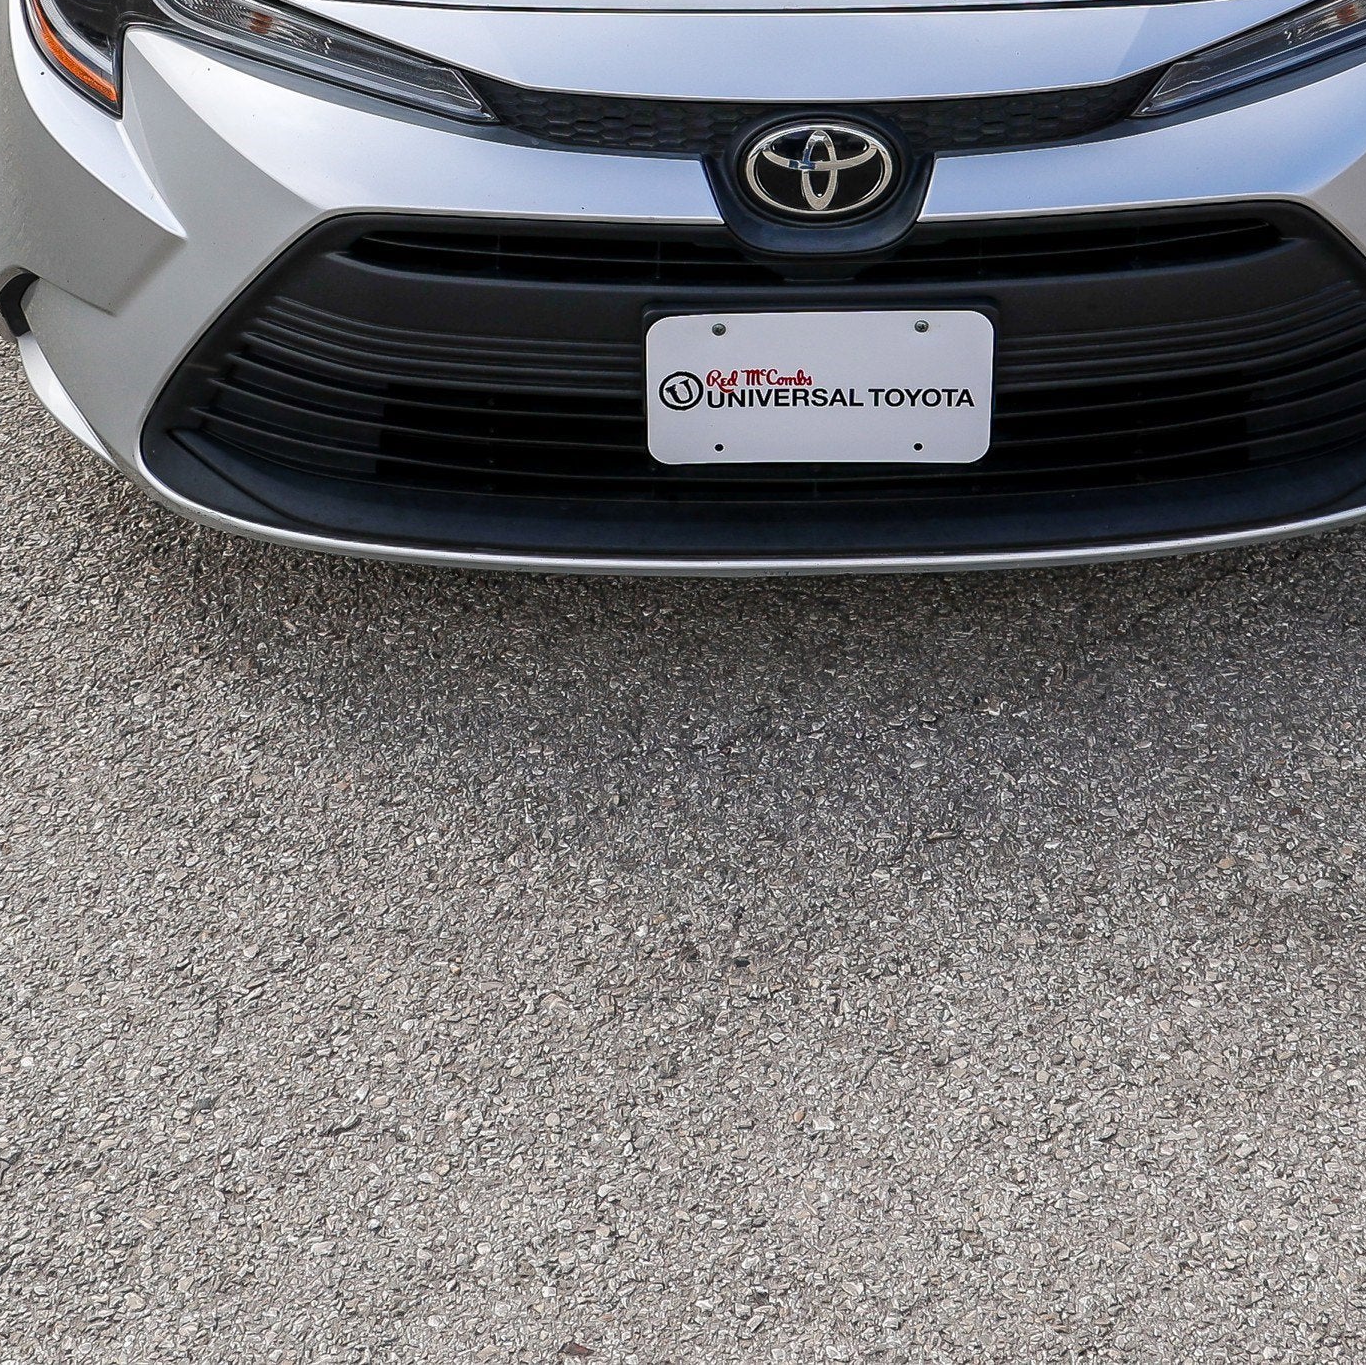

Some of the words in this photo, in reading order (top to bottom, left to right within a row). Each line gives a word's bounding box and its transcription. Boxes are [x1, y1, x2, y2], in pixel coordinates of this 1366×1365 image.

[706, 369, 738, 393] Red
[706, 388, 864, 408] UNIVERSAL
[868, 388, 975, 407] TOYOTA
